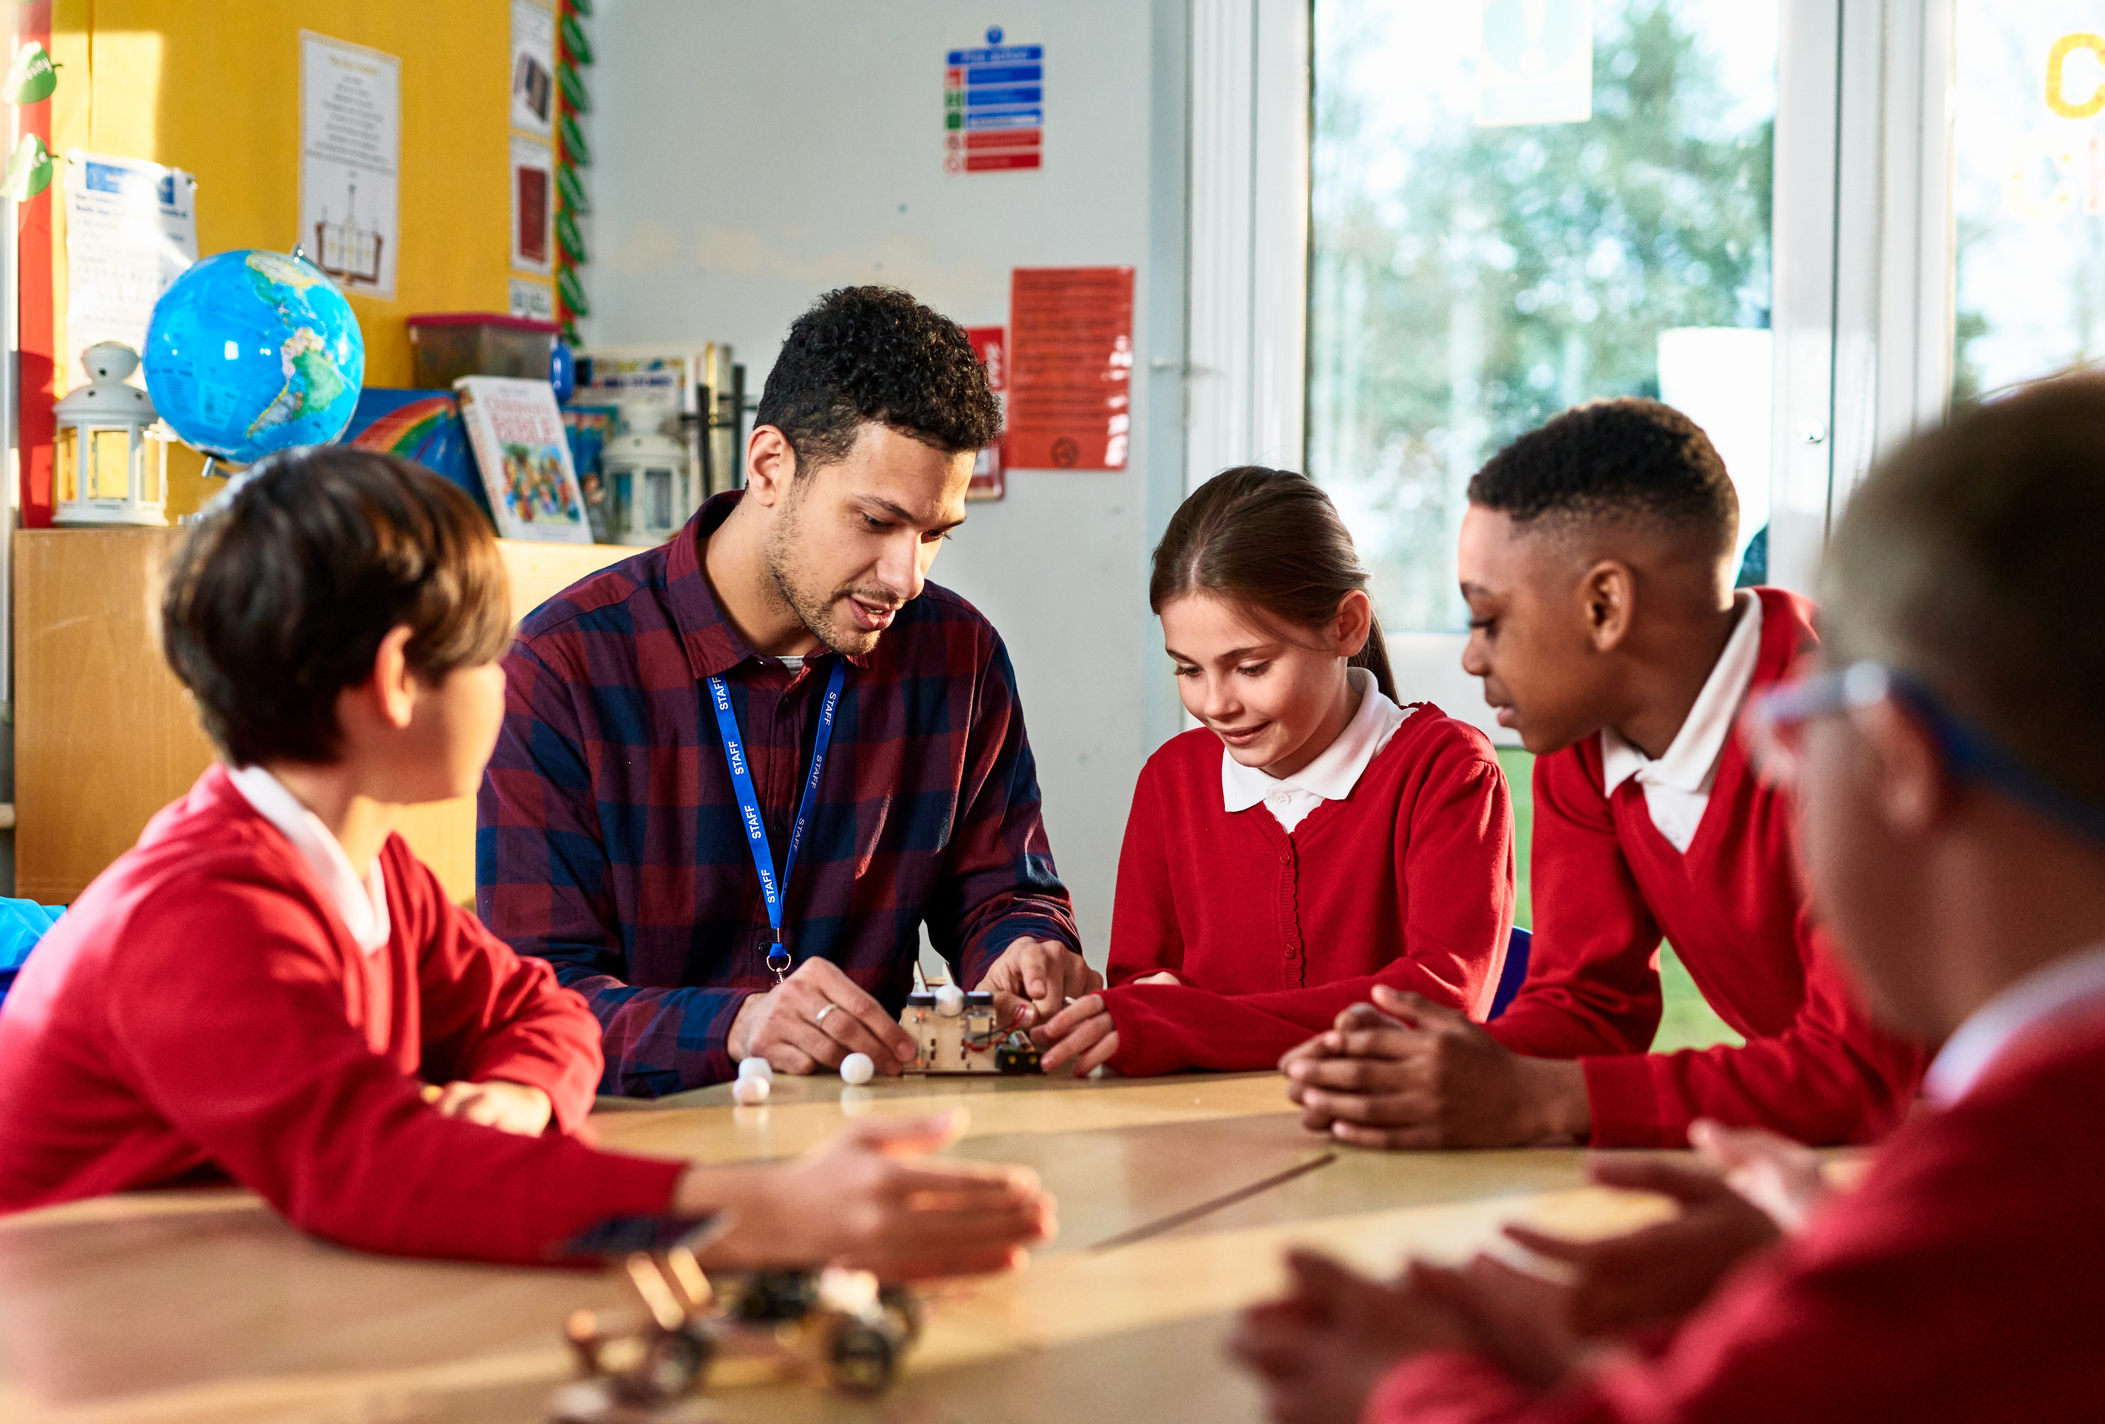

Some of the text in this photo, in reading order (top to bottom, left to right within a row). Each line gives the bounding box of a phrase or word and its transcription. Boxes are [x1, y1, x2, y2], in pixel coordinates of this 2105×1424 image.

[711, 677, 729, 711] STAFF
[823, 691, 837, 726] STAFF
[728, 741, 745, 775] STAFF
[811, 755, 823, 790] STAFF
[744, 805, 762, 839] STAFF
[761, 869, 776, 904] STAFF
